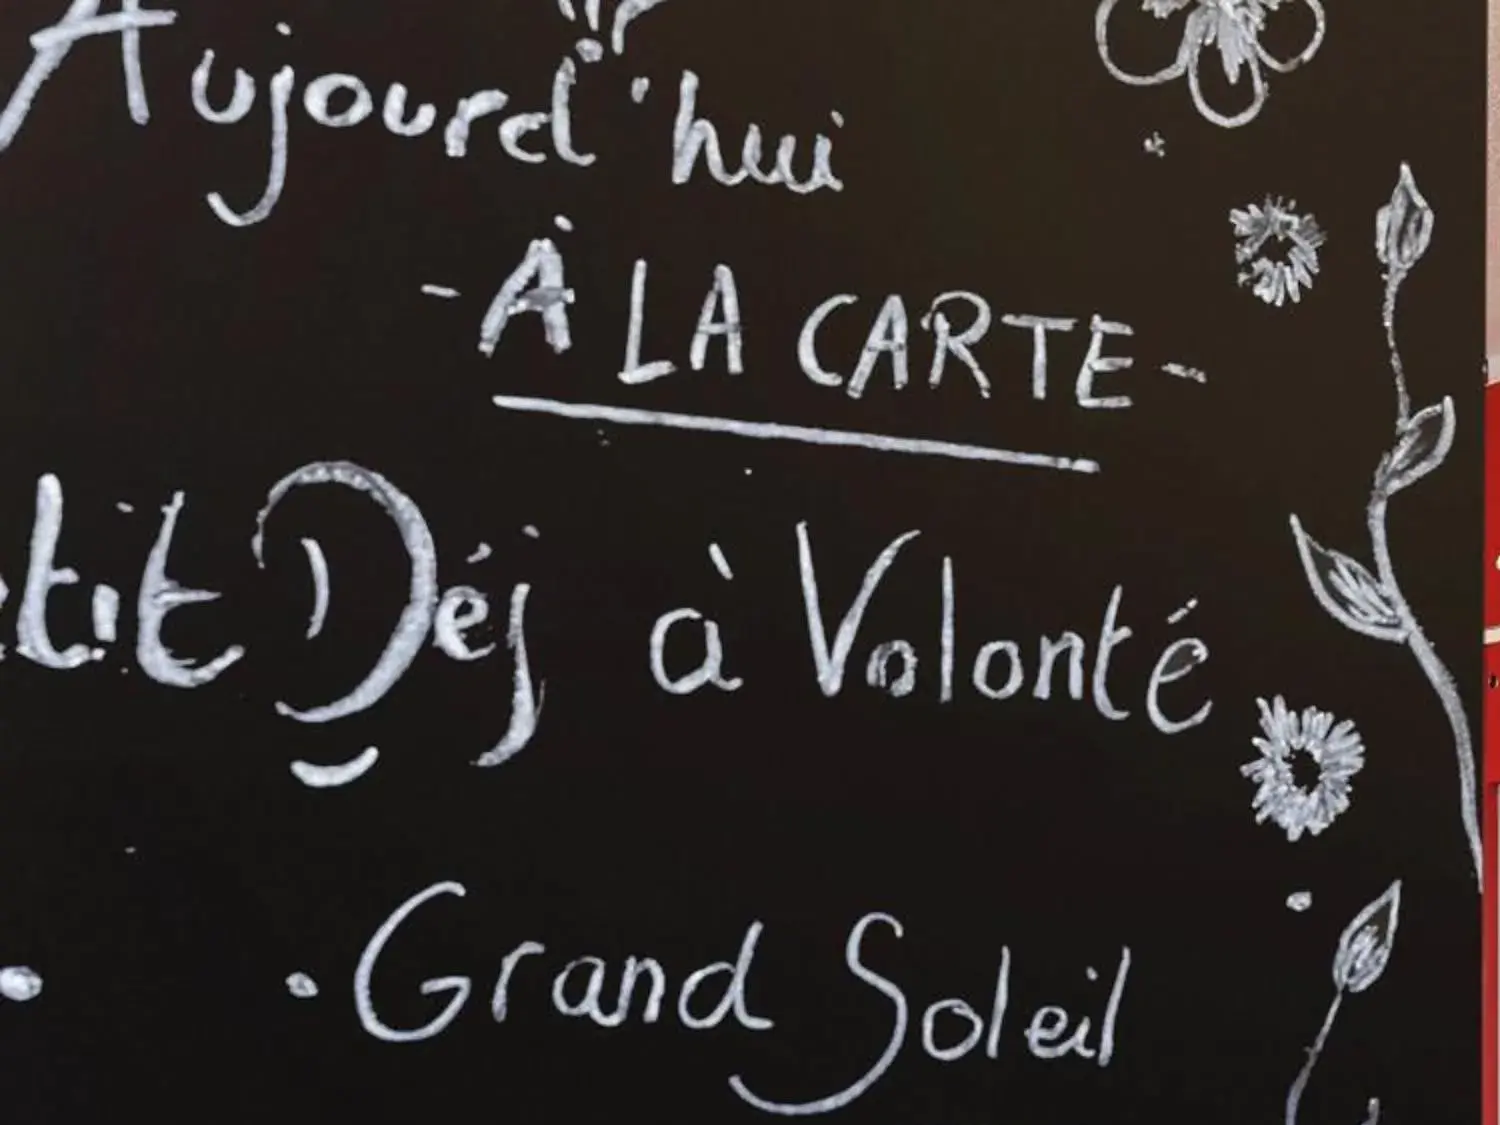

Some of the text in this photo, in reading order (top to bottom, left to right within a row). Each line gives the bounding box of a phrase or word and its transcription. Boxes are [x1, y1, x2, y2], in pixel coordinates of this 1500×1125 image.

[618, 259, 743, 384] LA
[798, 291, 1133, 408] CARTE
[252, 461, 546, 766] Déj
[650, 544, 742, 694] à
[796, 521, 1212, 733] Volonté
[355, 881, 1131, 1115] Grand Soleil
